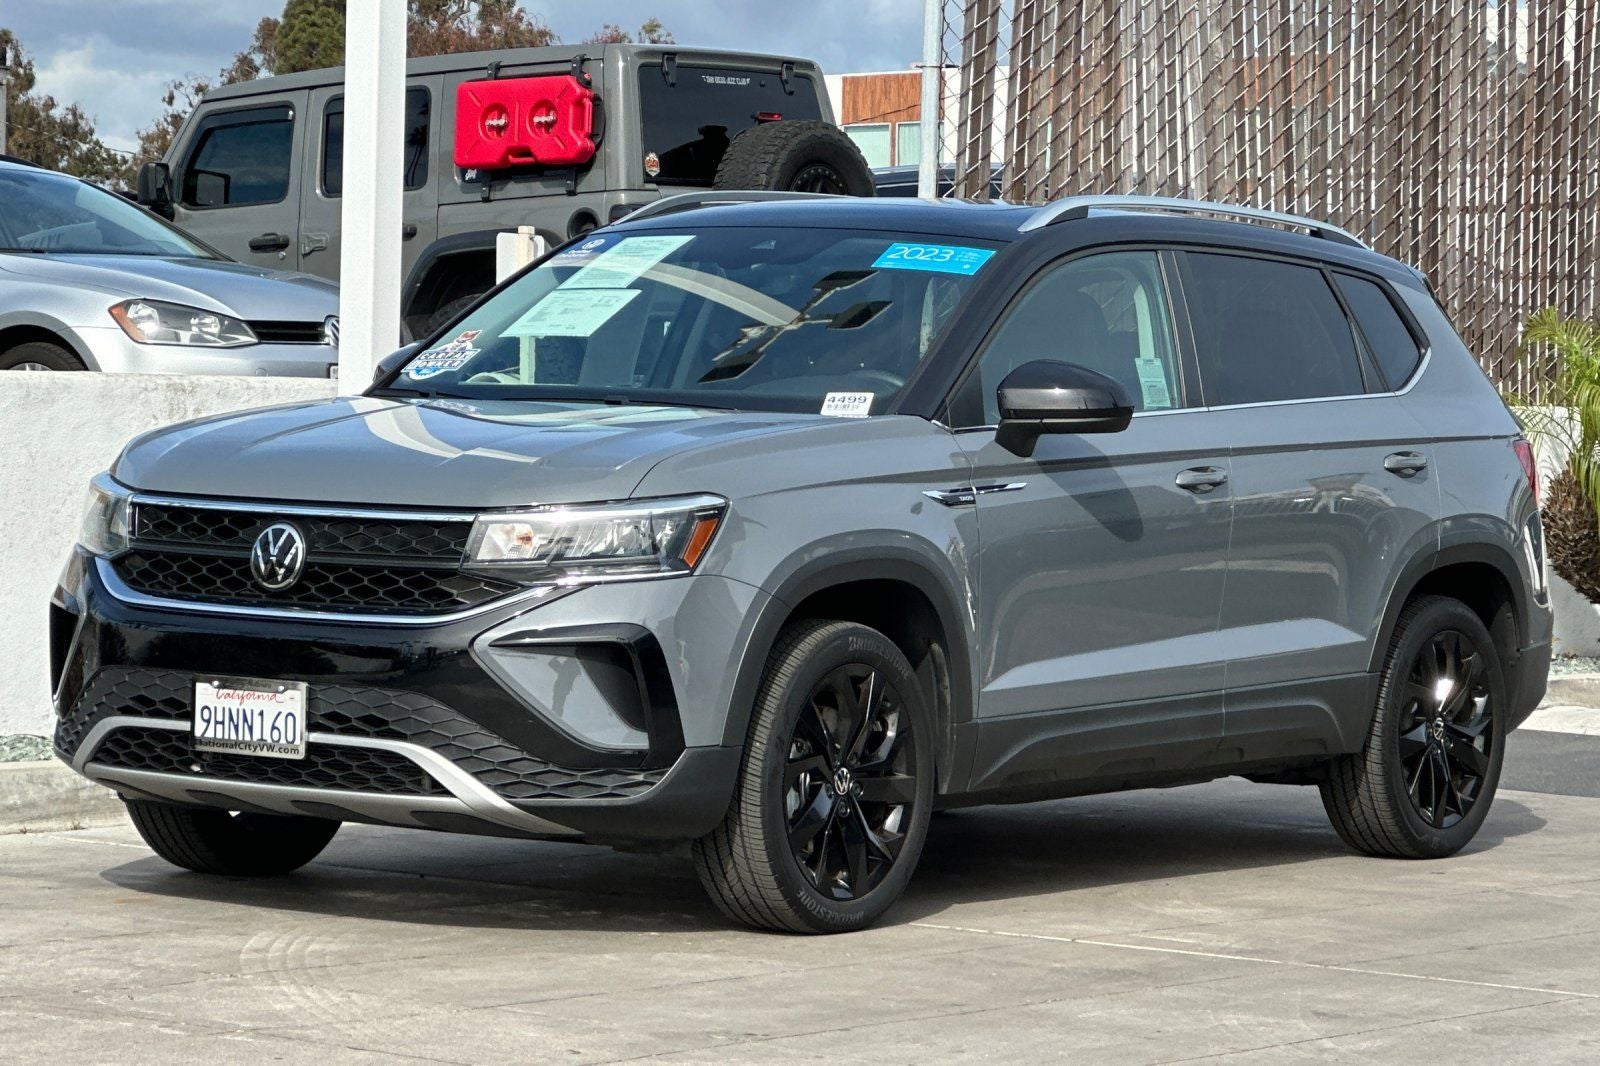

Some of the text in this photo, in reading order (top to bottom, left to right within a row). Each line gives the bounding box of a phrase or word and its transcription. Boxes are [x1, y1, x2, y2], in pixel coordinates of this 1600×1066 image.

[887, 246, 955, 261] 2023
[848, 636, 910, 680] BRIDGESTONE
[216, 688, 284, 705] California
[201, 705, 296, 745] 9HNN160
[796, 887, 864, 923] BRIDGESTONE
